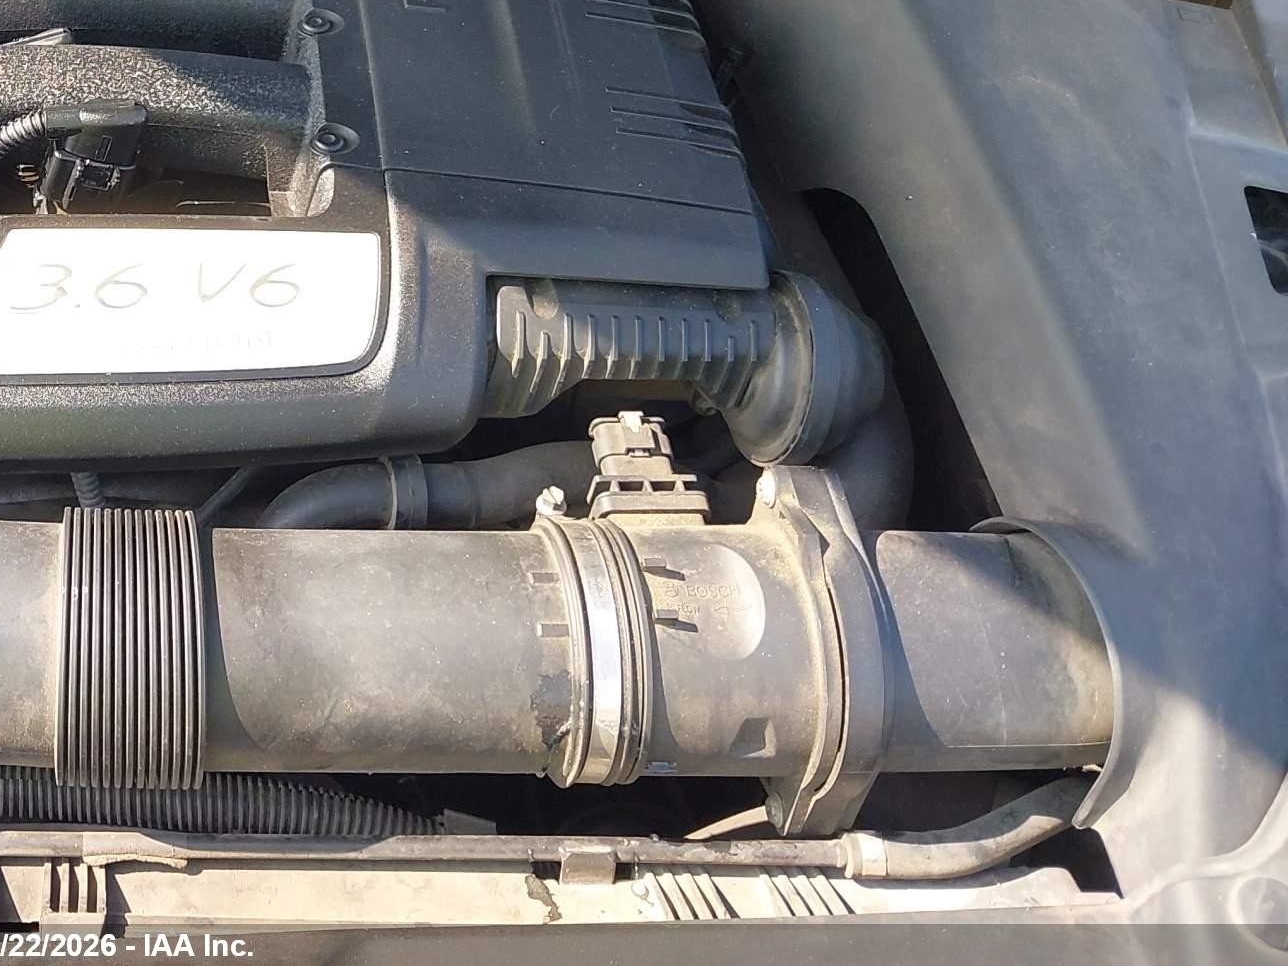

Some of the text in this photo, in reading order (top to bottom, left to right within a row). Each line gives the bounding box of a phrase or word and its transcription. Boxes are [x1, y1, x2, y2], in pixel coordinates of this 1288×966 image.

[9, 262, 300, 313] 3.6 V6
[685, 584, 741, 599] BOSCH
